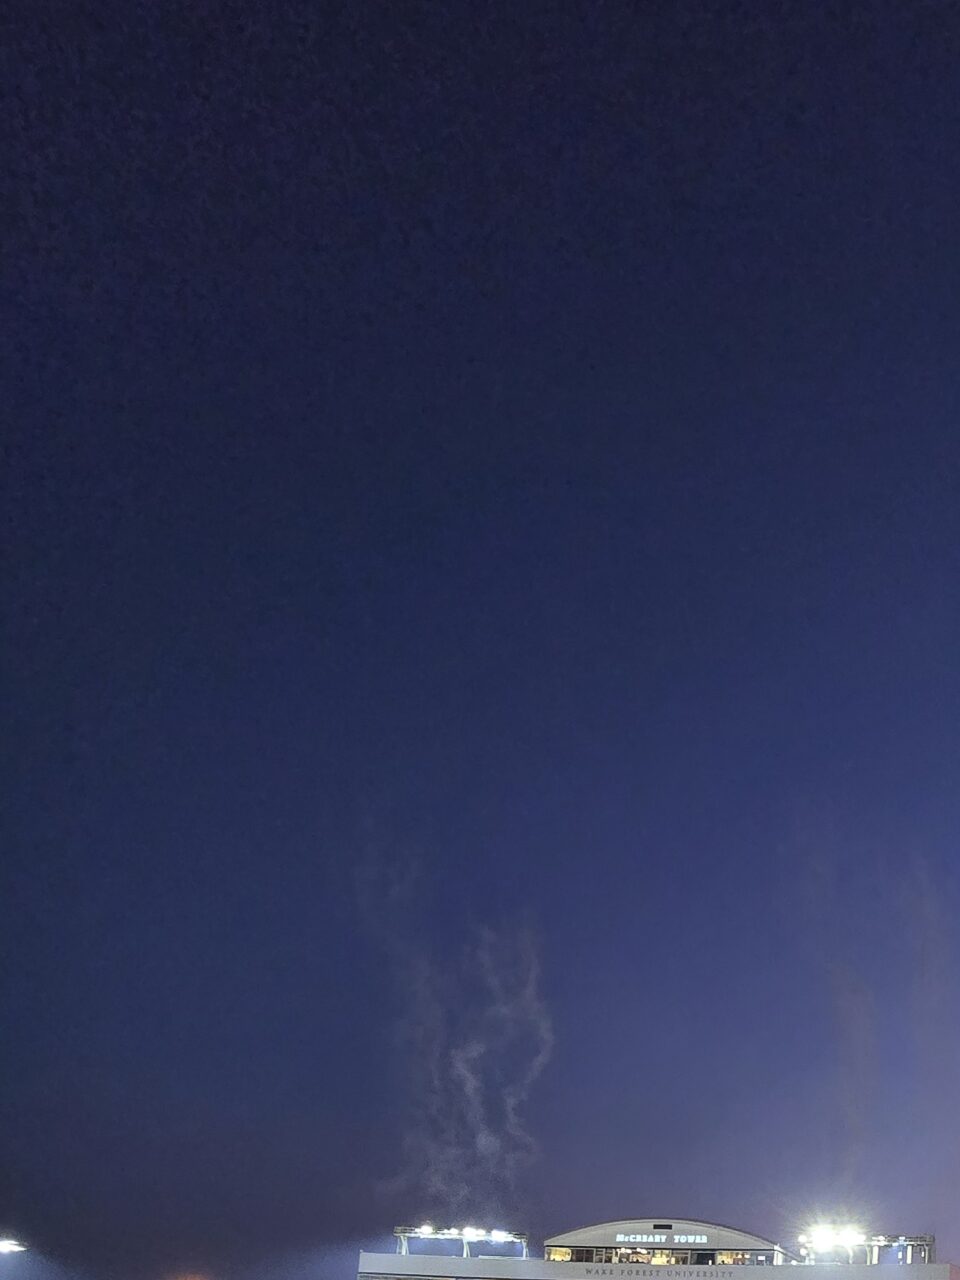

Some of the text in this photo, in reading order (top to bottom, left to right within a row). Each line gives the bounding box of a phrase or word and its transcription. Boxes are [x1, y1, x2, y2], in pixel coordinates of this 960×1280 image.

[616, 1234, 708, 1243] McCREARY TOWER
[620, 1269, 660, 1277] FOREST
[667, 1270, 734, 1278] UNIVERSITY
